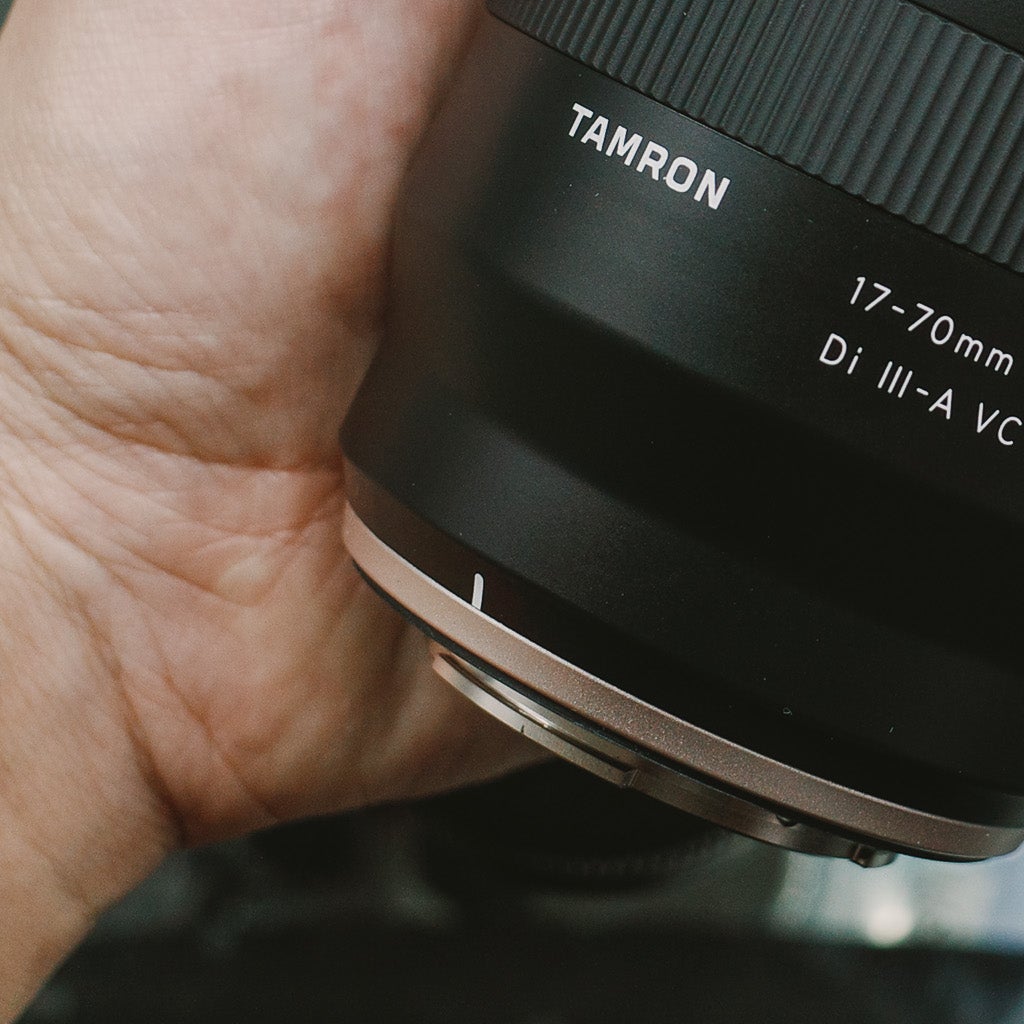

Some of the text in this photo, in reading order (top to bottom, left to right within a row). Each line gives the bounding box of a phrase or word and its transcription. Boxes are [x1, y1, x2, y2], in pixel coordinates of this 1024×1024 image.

[568, 102, 731, 210] TAMRON
[850, 276, 1014, 376] 17-70mm
[819, 333, 863, 374] Di
[877, 361, 953, 419] III-A
[976, 402, 1023, 446] VC
